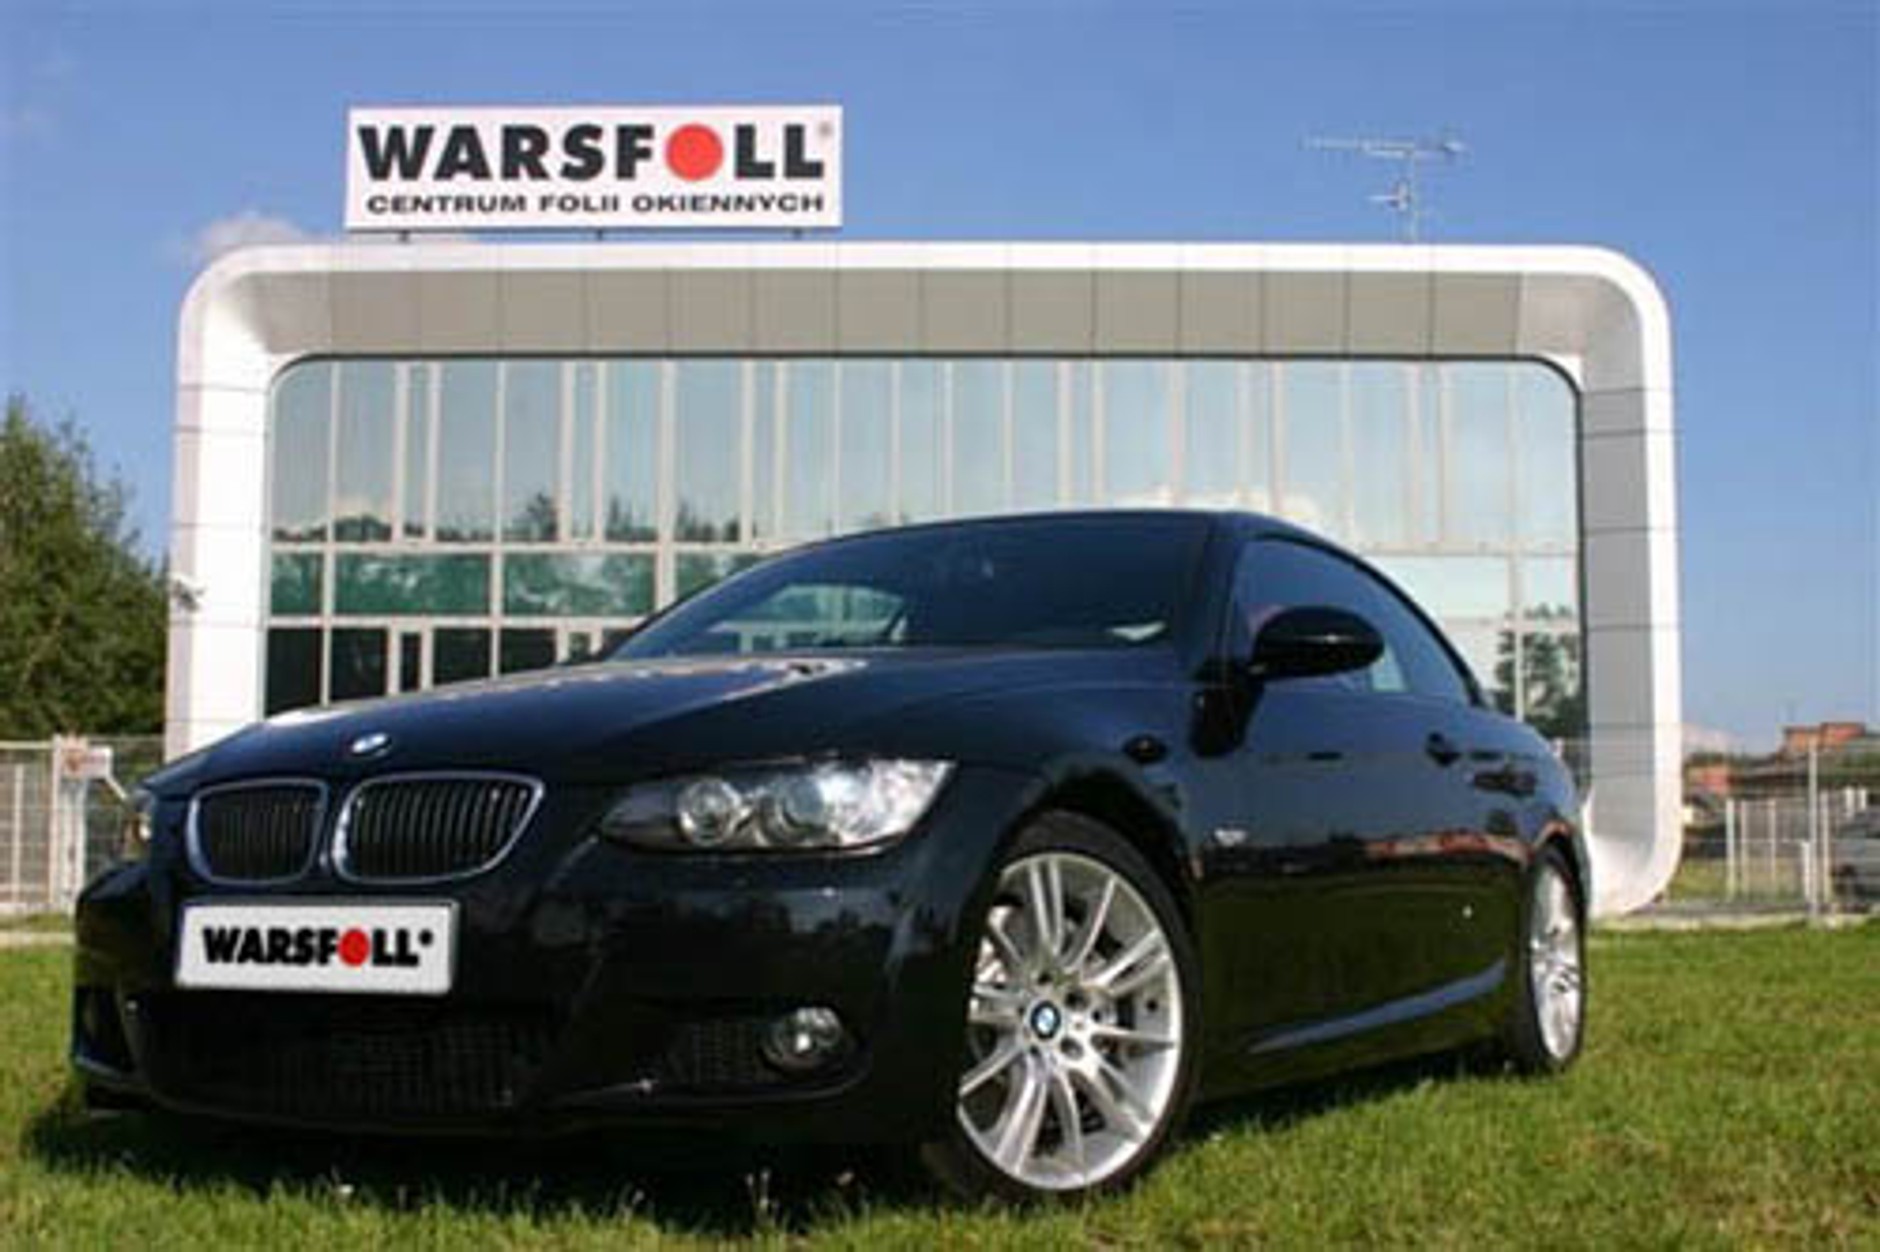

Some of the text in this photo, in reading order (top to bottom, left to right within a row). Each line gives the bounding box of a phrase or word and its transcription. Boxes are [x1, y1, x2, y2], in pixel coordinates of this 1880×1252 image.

[357, 122, 825, 181] WARSFOLL
[366, 193, 825, 214] CENTRUM FOLII OKIENNYCH
[203, 926, 420, 969] WARSFOLL
